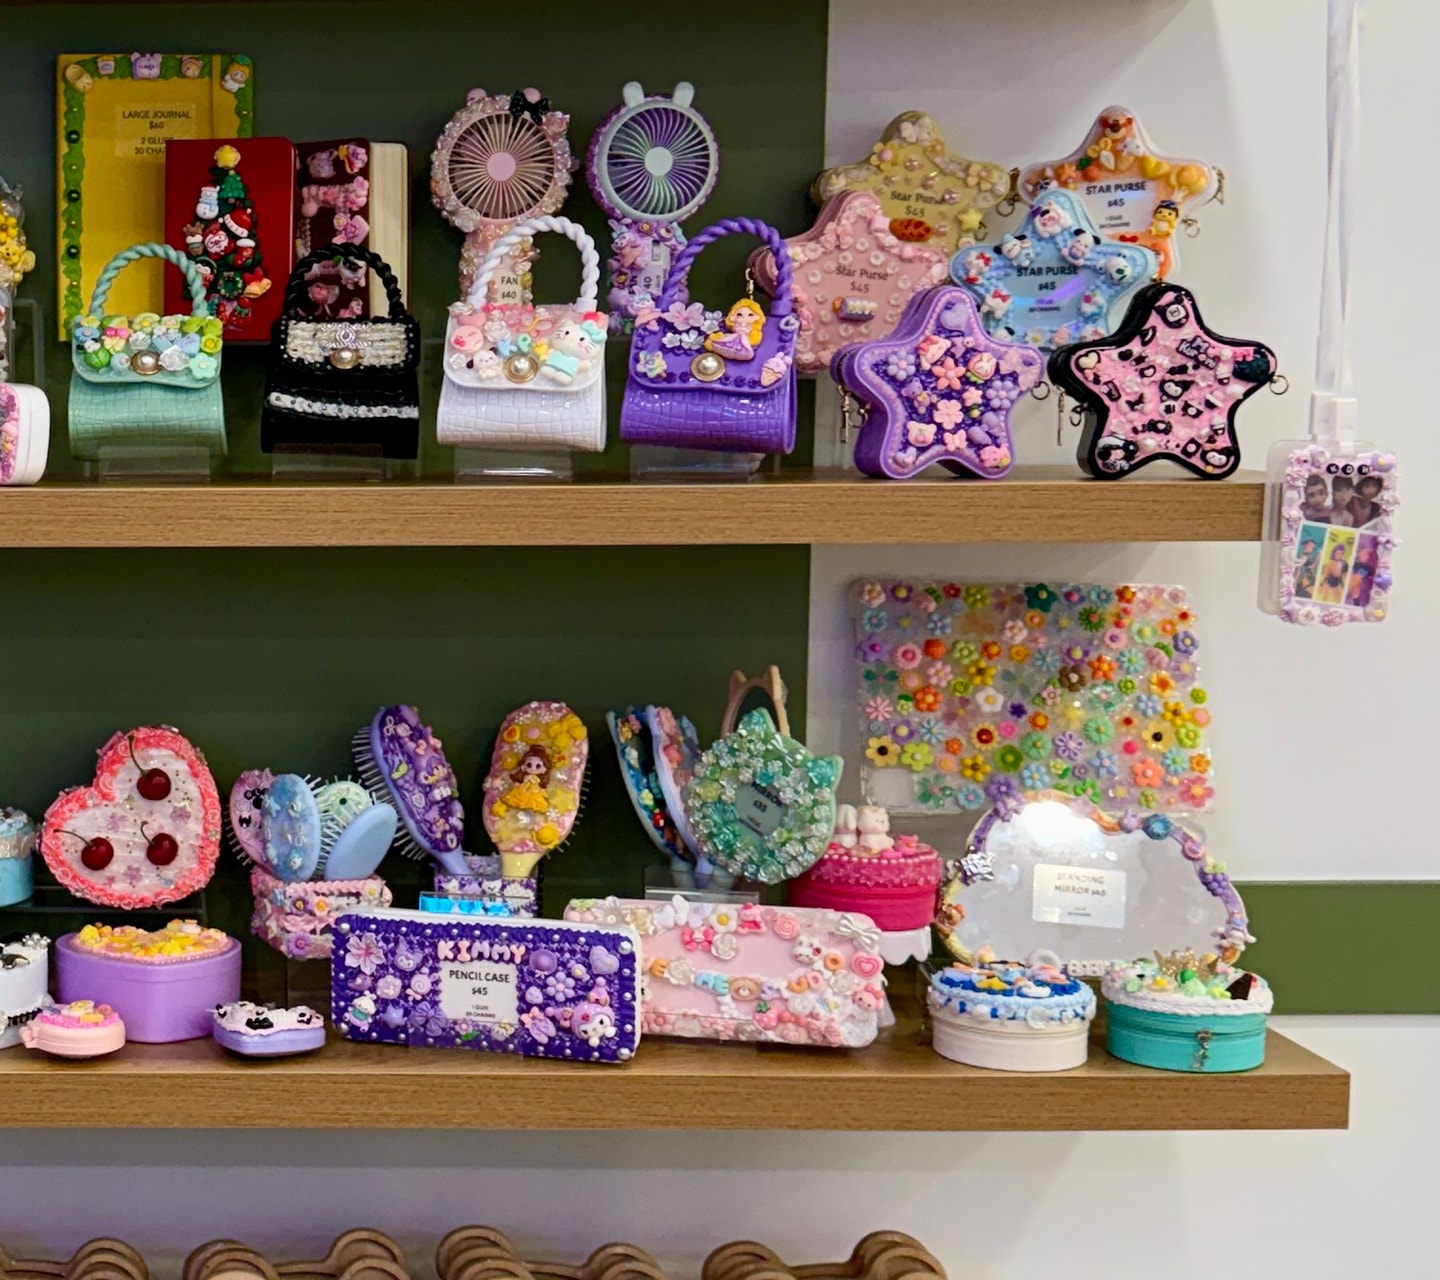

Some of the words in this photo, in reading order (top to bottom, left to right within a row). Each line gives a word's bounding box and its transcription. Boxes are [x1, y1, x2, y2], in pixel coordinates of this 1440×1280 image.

[122, 110, 151, 119] LARGE
[152, 110, 192, 119] JOURNAL
[1086, 185, 1113, 195] STAR
[1114, 182, 1147, 192] PURSE
[891, 191, 912, 201] Star
[1107, 199, 1125, 208] $45
[905, 205, 924, 217] $45
[836, 265, 856, 277] Star
[860, 269, 888, 281] Purse
[1017, 266, 1046, 277] STAR
[1047, 265, 1079, 276] PURSE
[501, 276, 518, 285] FAN
[850, 281, 869, 293] $45
[502, 291, 517, 299] $40
[438, 941, 526, 964] KIMMY
[450, 970, 483, 981] PENCIL
[485, 973, 510, 983] CASE
[472, 987, 488, 995] $45
